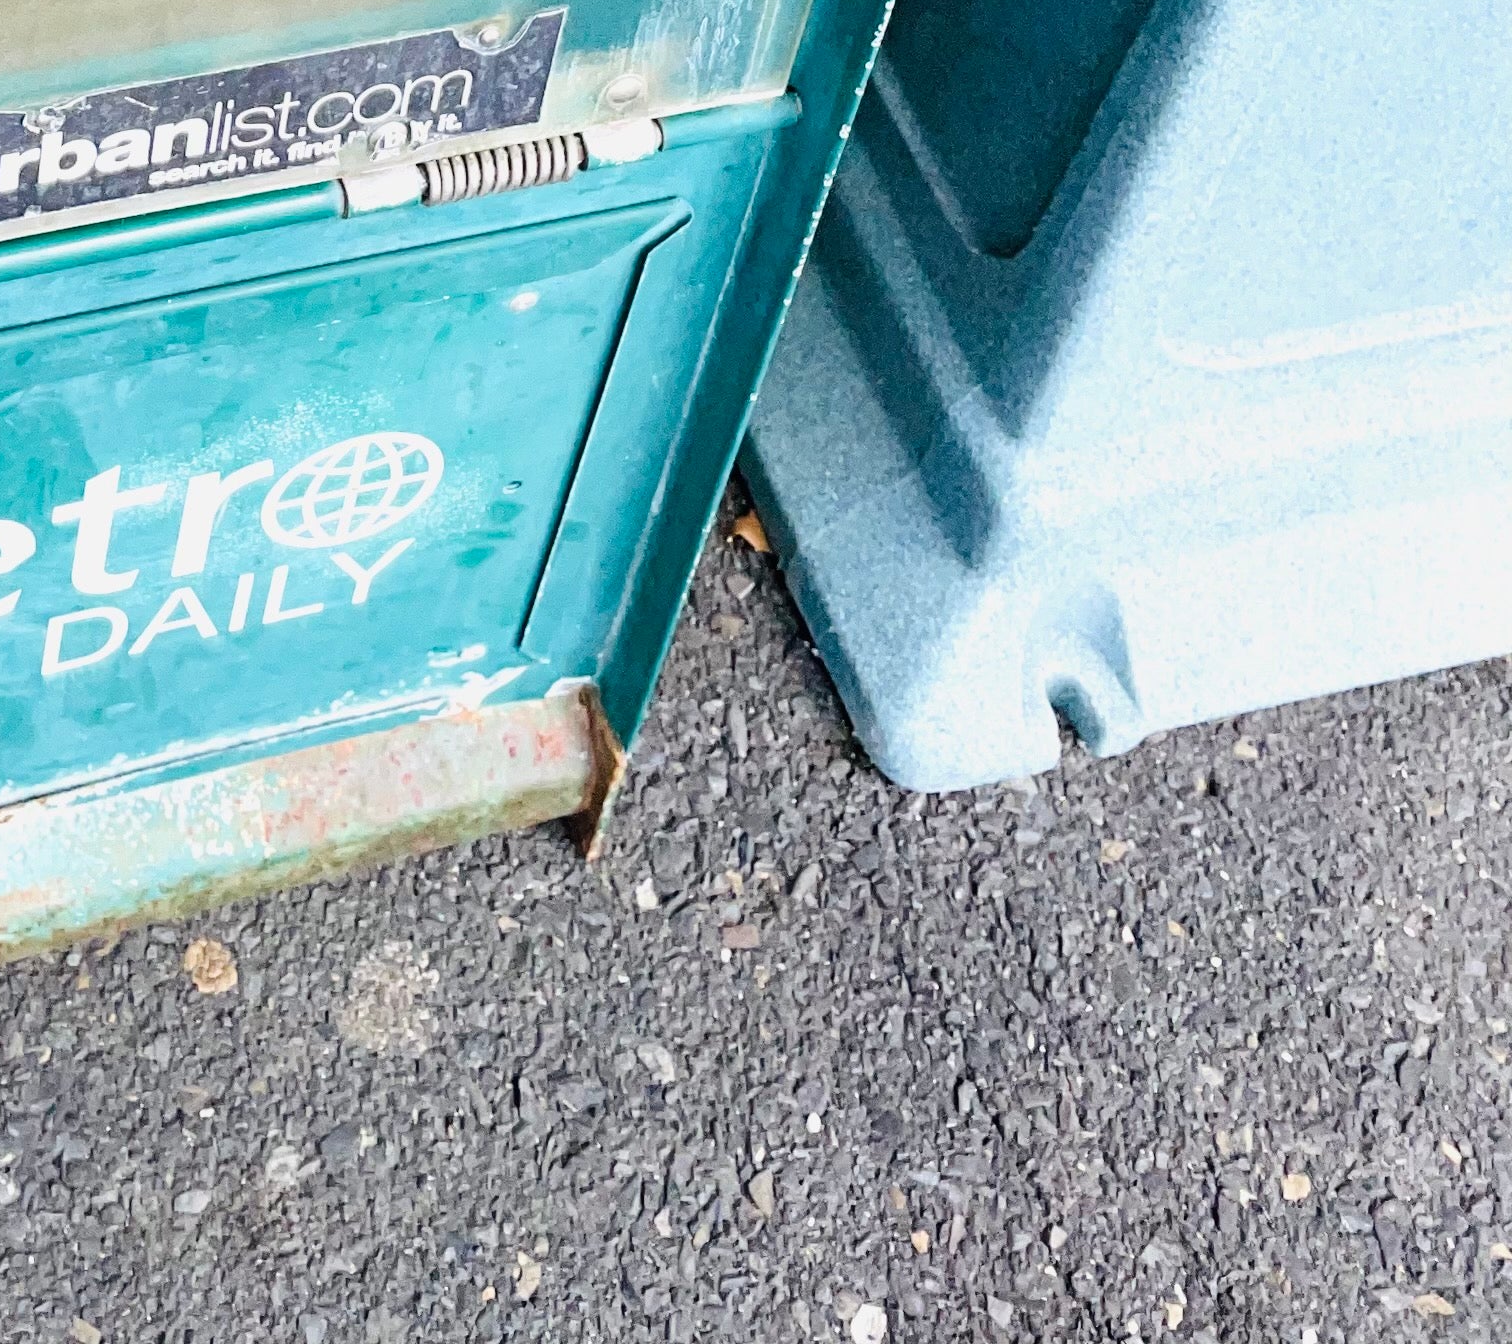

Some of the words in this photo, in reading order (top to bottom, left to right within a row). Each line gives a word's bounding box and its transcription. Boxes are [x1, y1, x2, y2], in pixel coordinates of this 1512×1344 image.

[148, 153, 248, 187] search
[252, 147, 281, 166] it.
[287, 133, 342, 162] find
[437, 113, 463, 132] it.
[39, 538, 418, 678] DAILY
